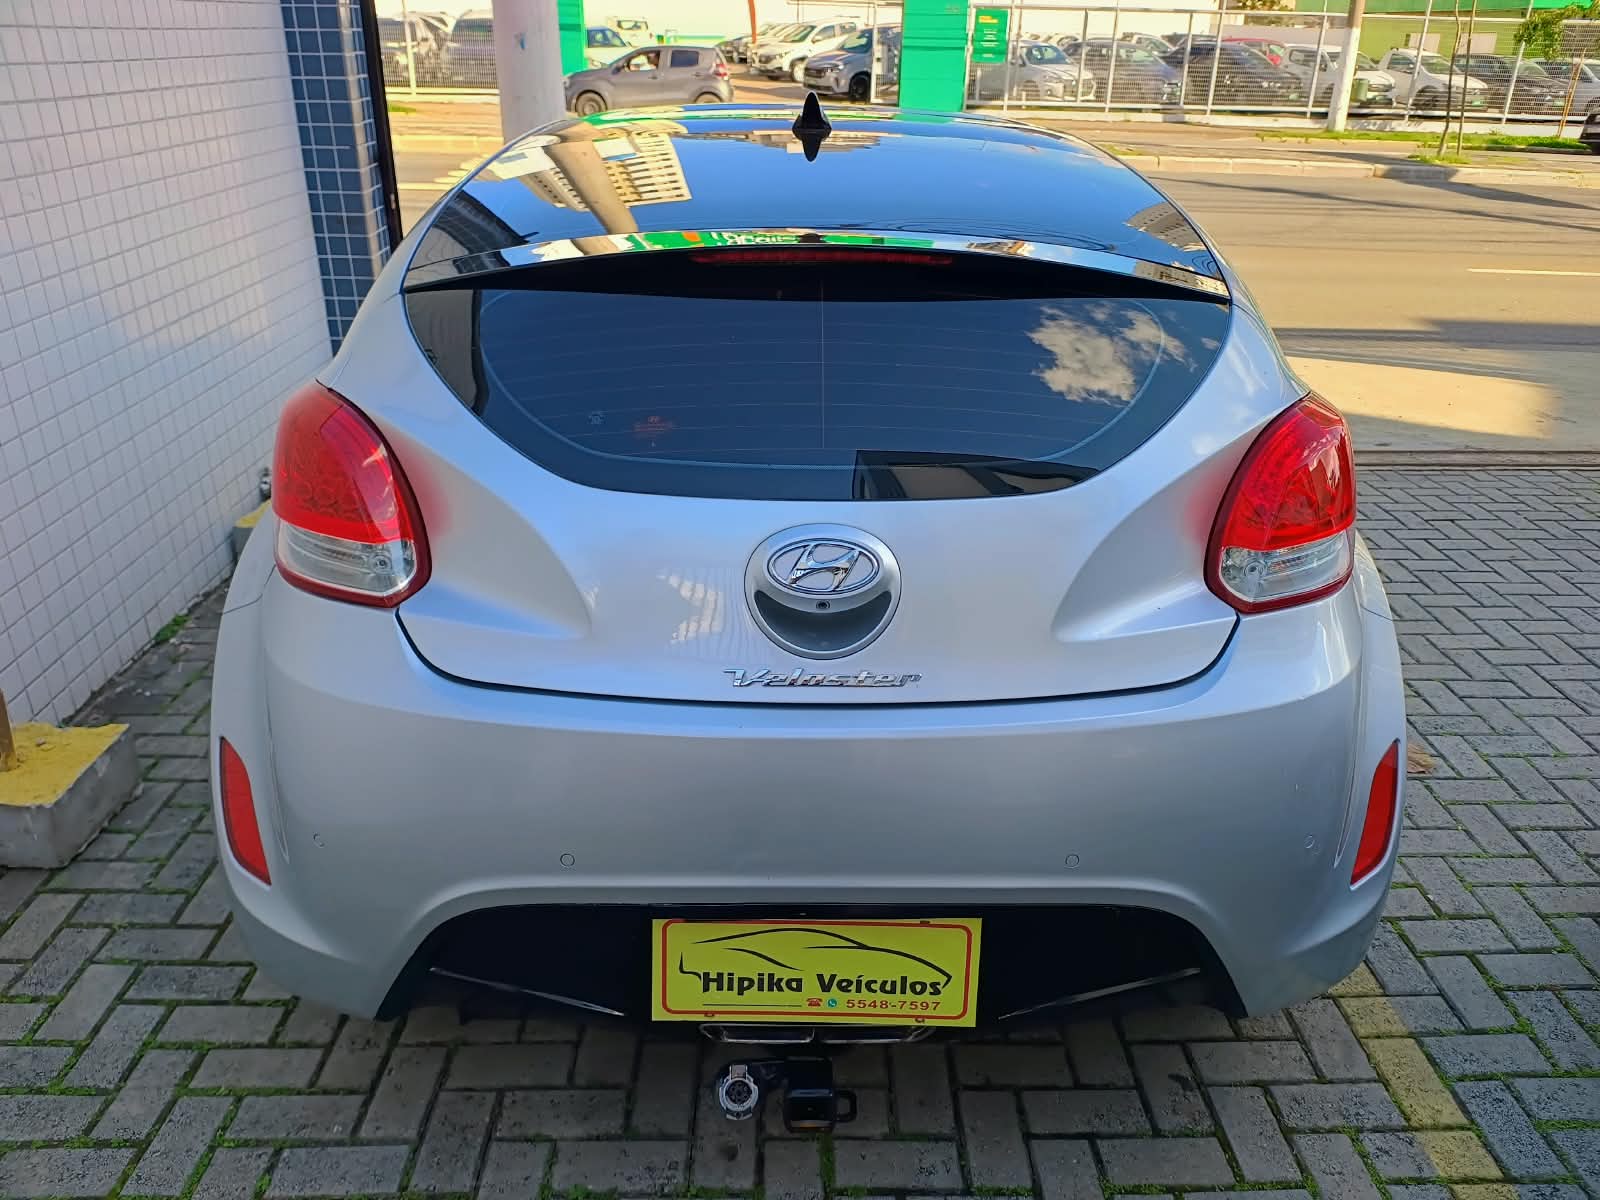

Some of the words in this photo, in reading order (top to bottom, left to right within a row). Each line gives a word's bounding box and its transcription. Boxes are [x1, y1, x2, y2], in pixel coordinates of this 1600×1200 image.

[723, 668, 922, 688] Veloster
[702, 972, 803, 996] Hipika
[816, 973, 942, 996] Veículos
[846, 999, 941, 1011] 5548-7597
